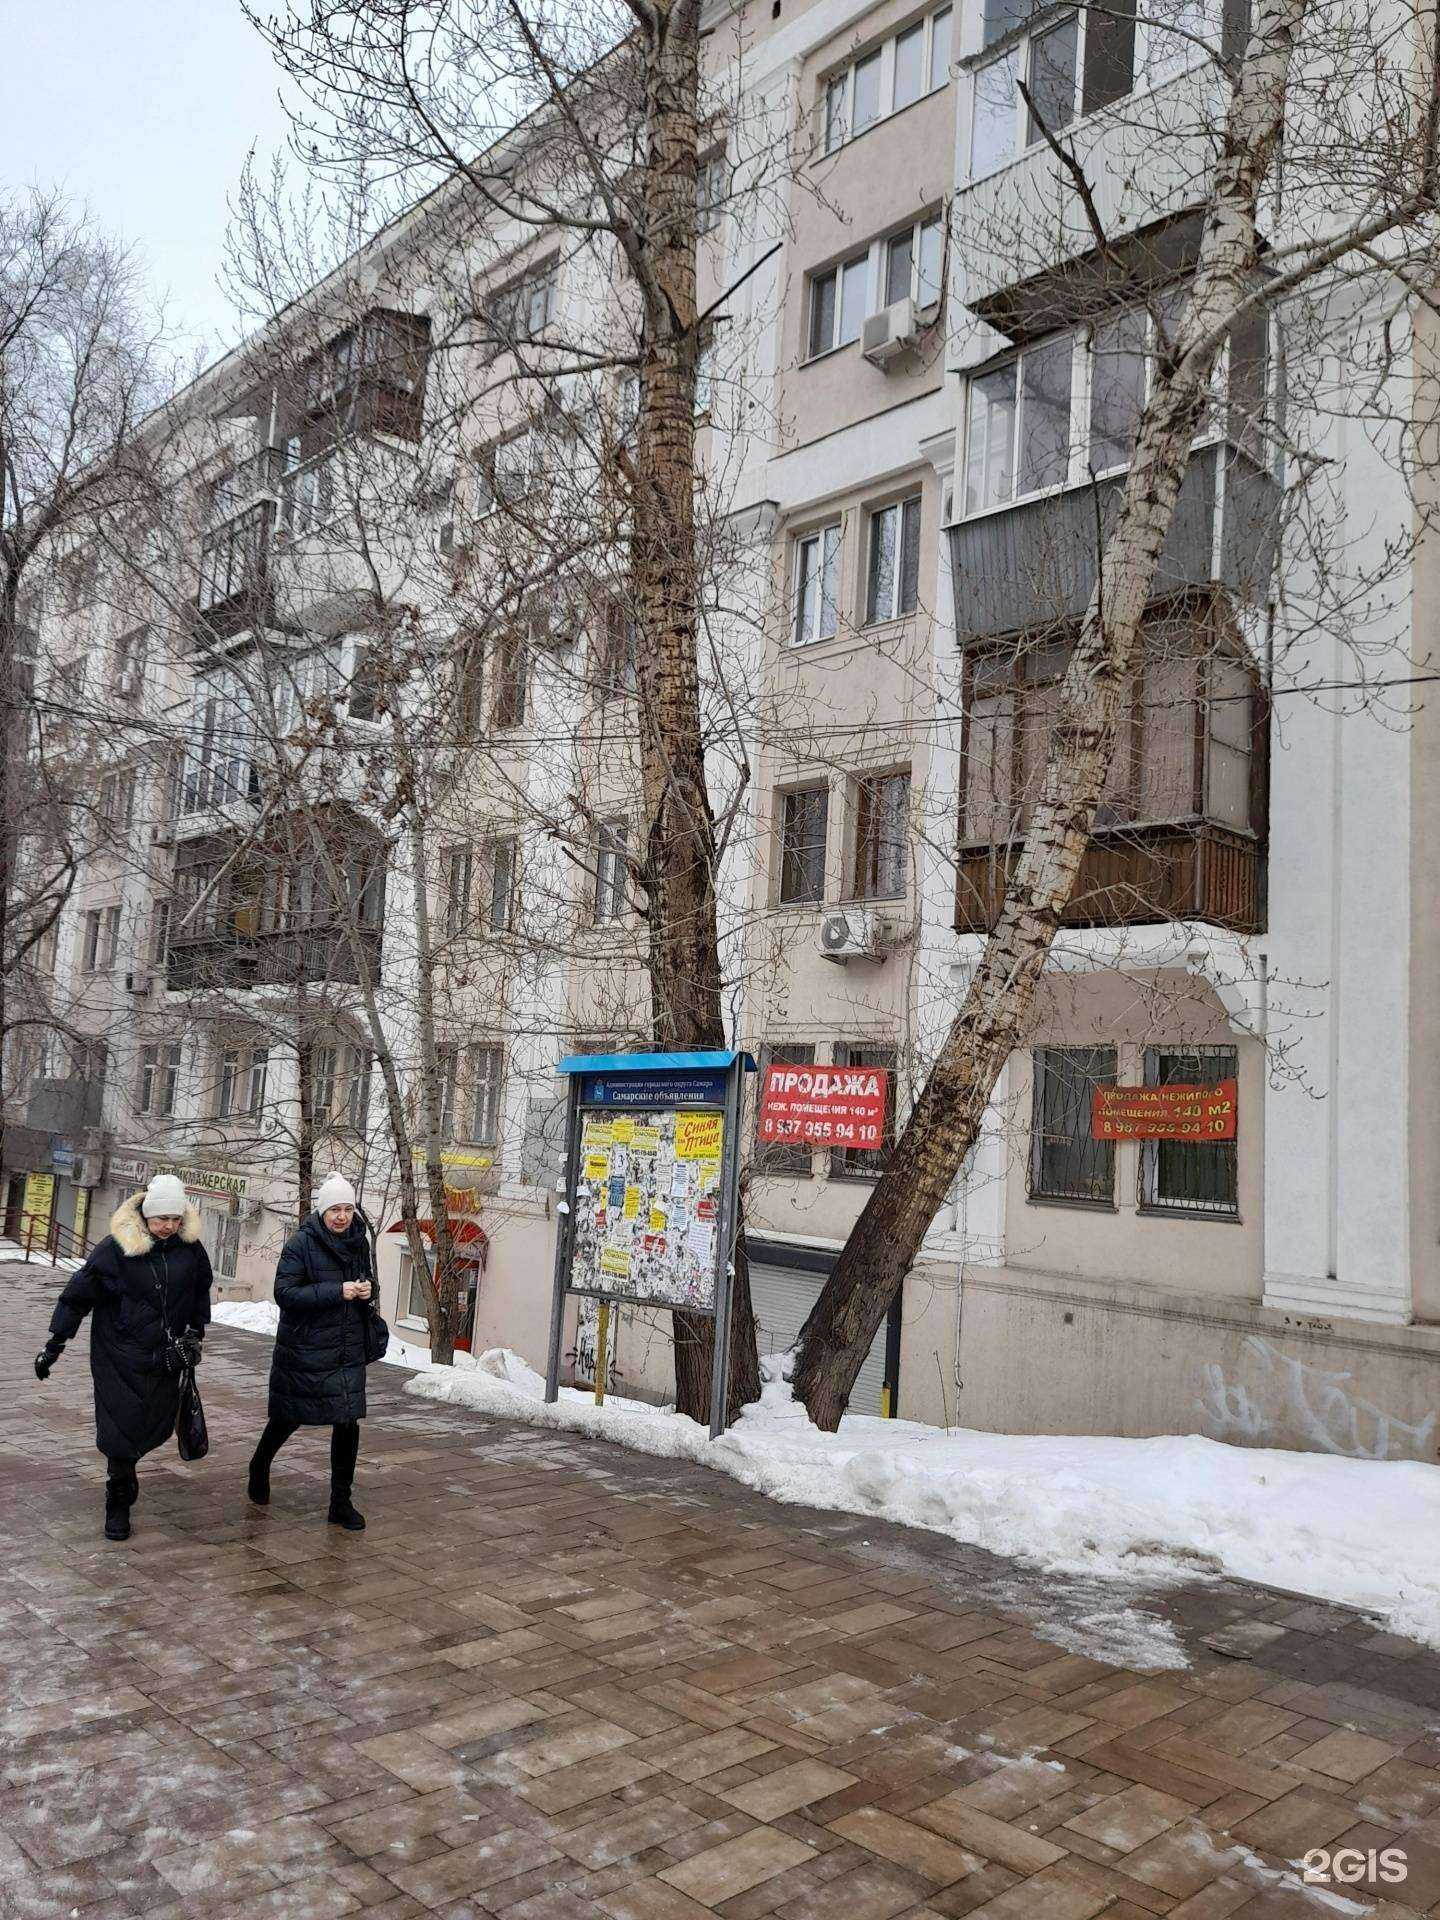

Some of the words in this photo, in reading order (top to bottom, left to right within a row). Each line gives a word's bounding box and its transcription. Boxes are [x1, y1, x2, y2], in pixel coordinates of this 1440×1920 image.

[769, 1072, 880, 1098] ПРОДАЖА
[612, 1091, 653, 1102] Самарские
[654, 1091, 704, 1101] объявления
[1103, 1091, 1159, 1102] ПРОДАЖА
[790, 1102, 847, 1115] ПОМЕЩЕНИЯ
[1173, 1105, 1202, 1118] 140
[764, 1119, 773, 1133] 8
[835, 1123, 854, 1139] 94
[859, 1125, 877, 1140] 10
[1103, 1119, 1112, 1133] 8
[1181, 1122, 1201, 1133] 94
[1207, 1119, 1225, 1133] 10
